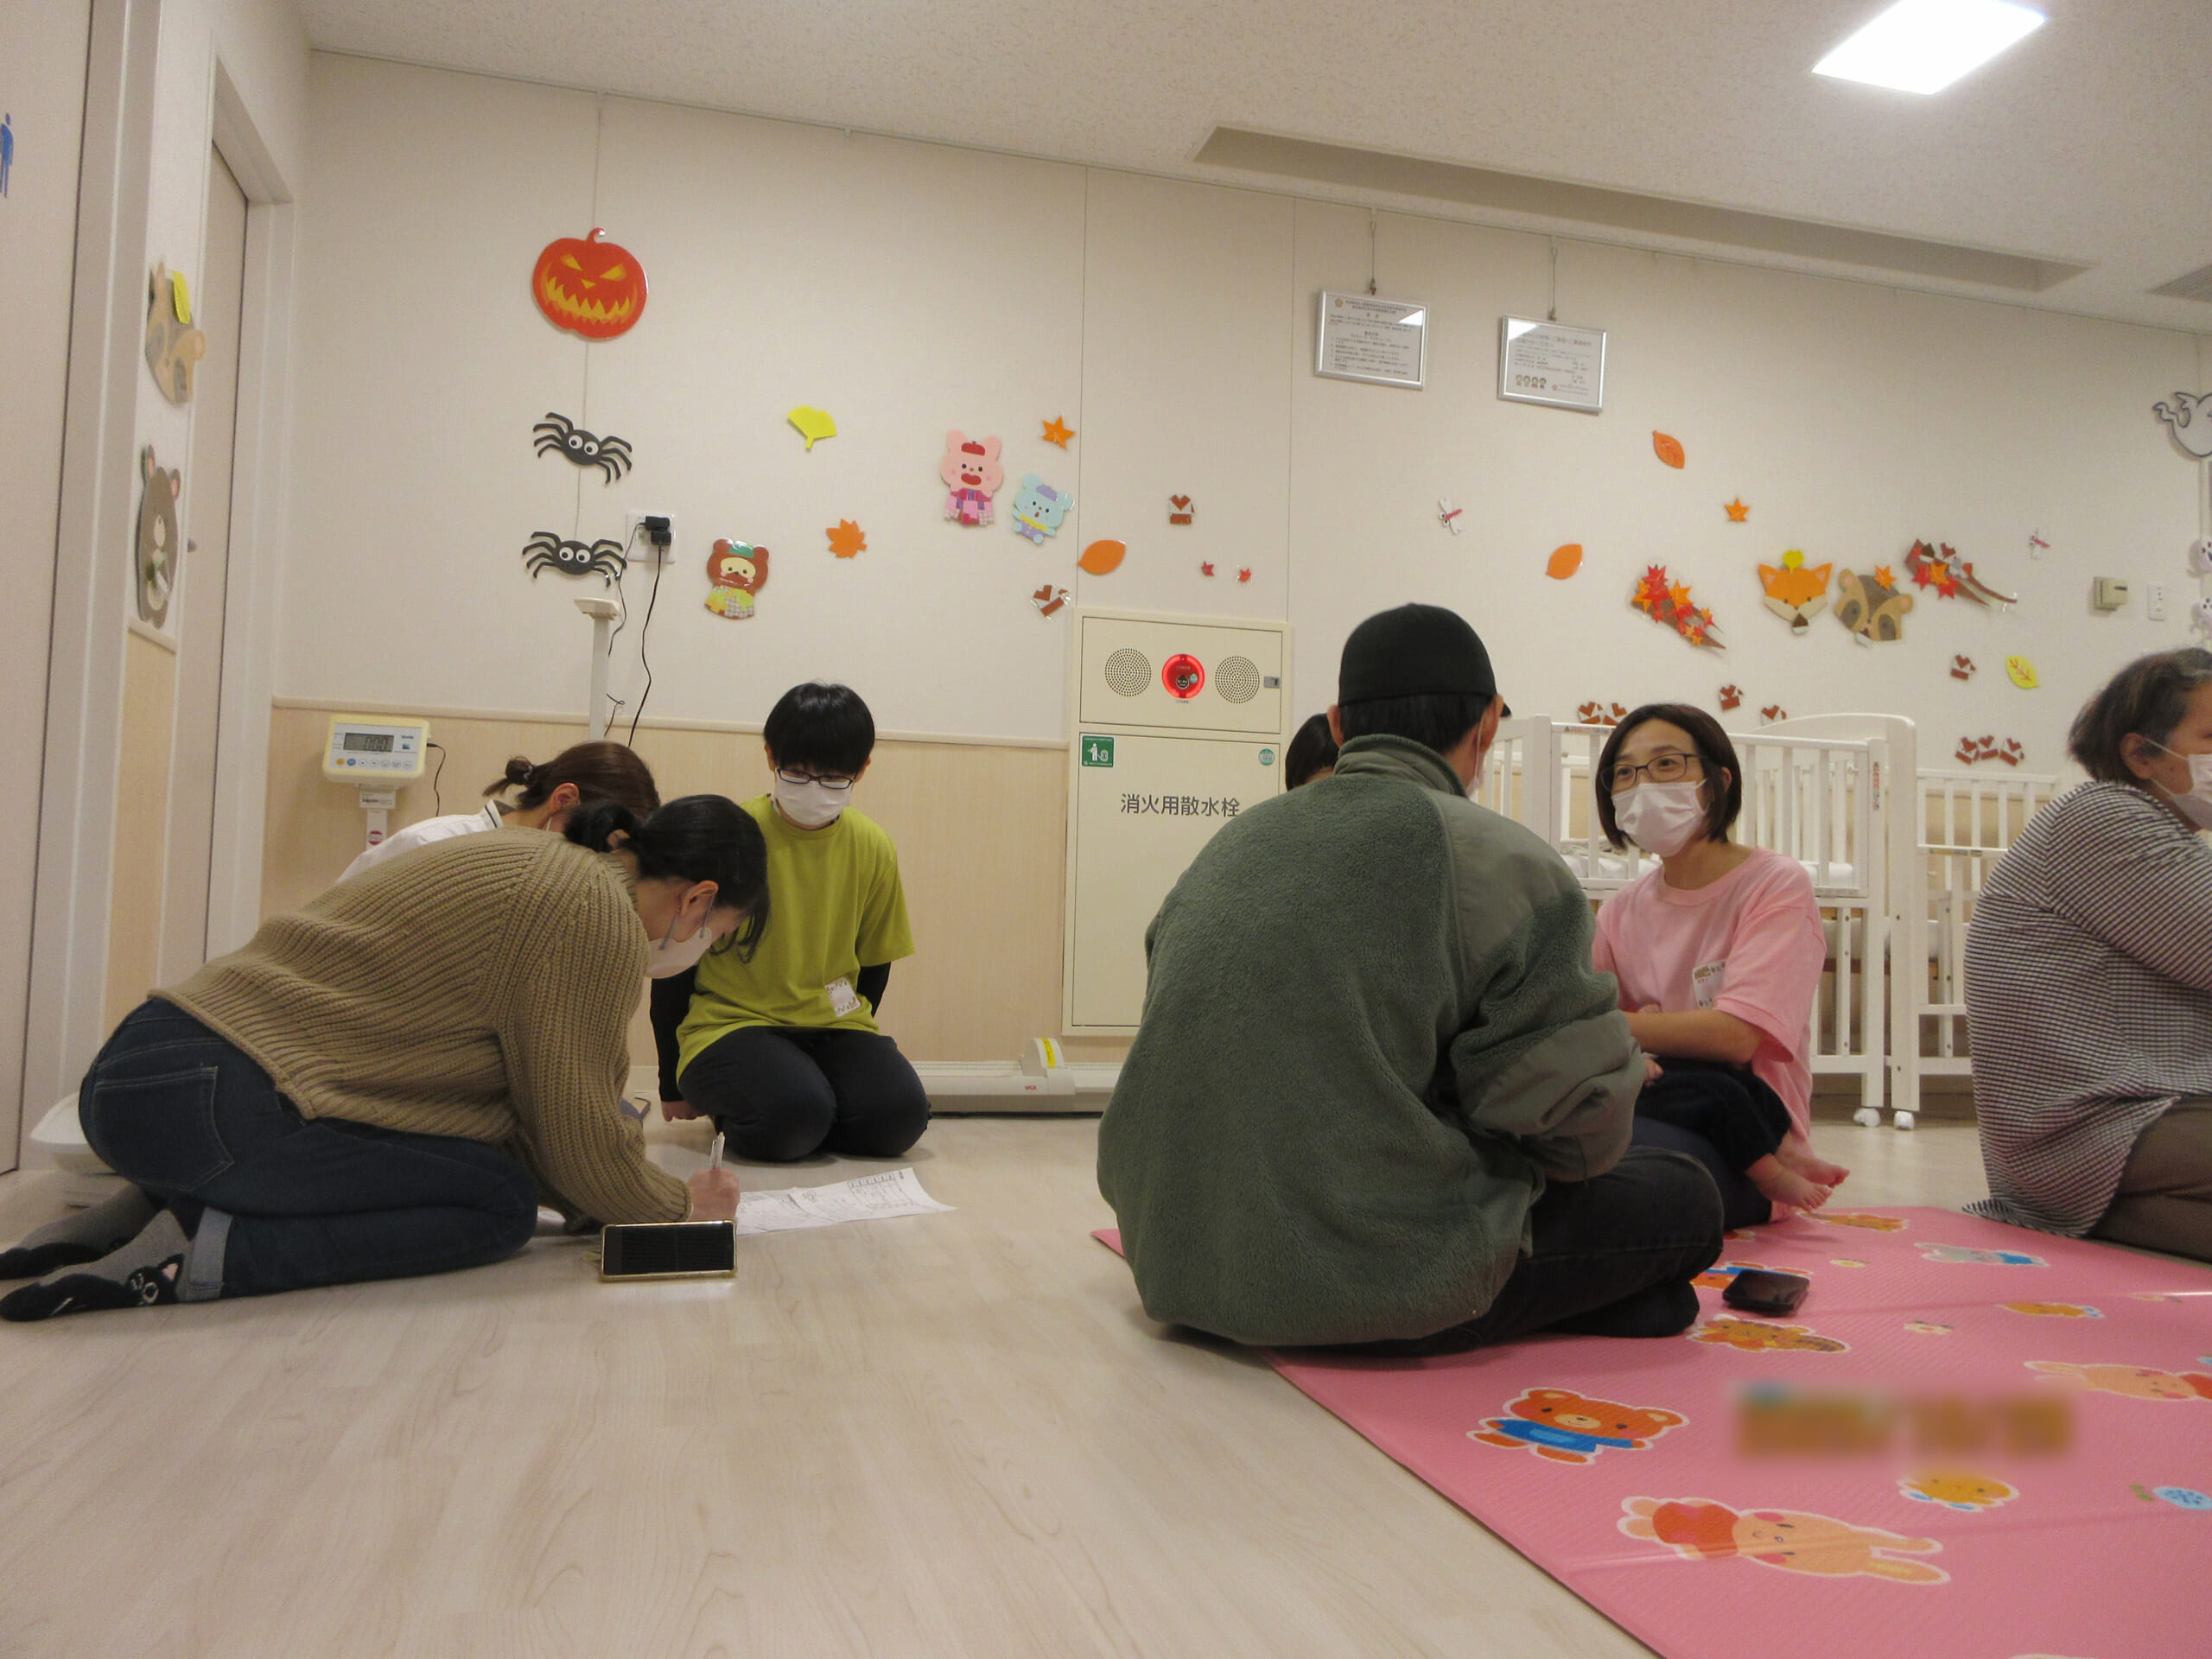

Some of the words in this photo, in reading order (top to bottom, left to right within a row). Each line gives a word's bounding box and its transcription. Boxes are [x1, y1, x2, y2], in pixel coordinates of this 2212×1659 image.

[1121, 793, 1240, 817] 消火用散水栓
